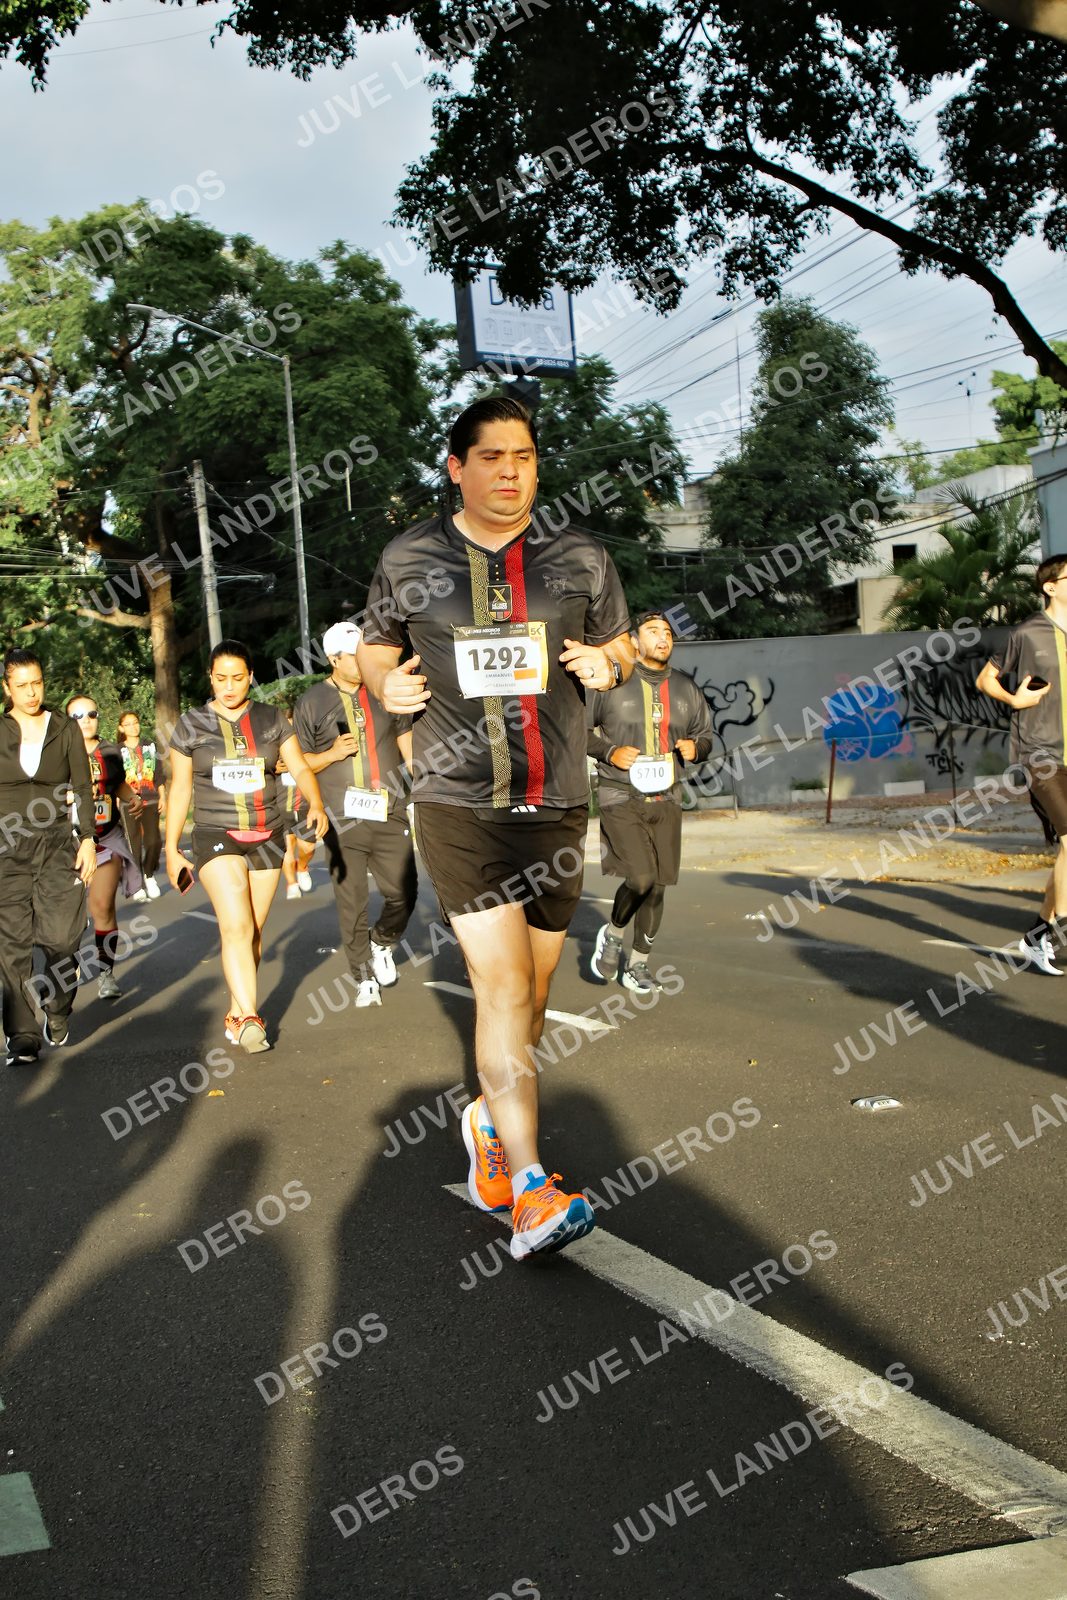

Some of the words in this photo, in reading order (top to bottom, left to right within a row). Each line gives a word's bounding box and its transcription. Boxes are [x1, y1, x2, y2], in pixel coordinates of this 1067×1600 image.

[468, 646, 527, 671] 1292
[637, 766, 665, 779] 5710
[351, 796, 379, 809] 7407
